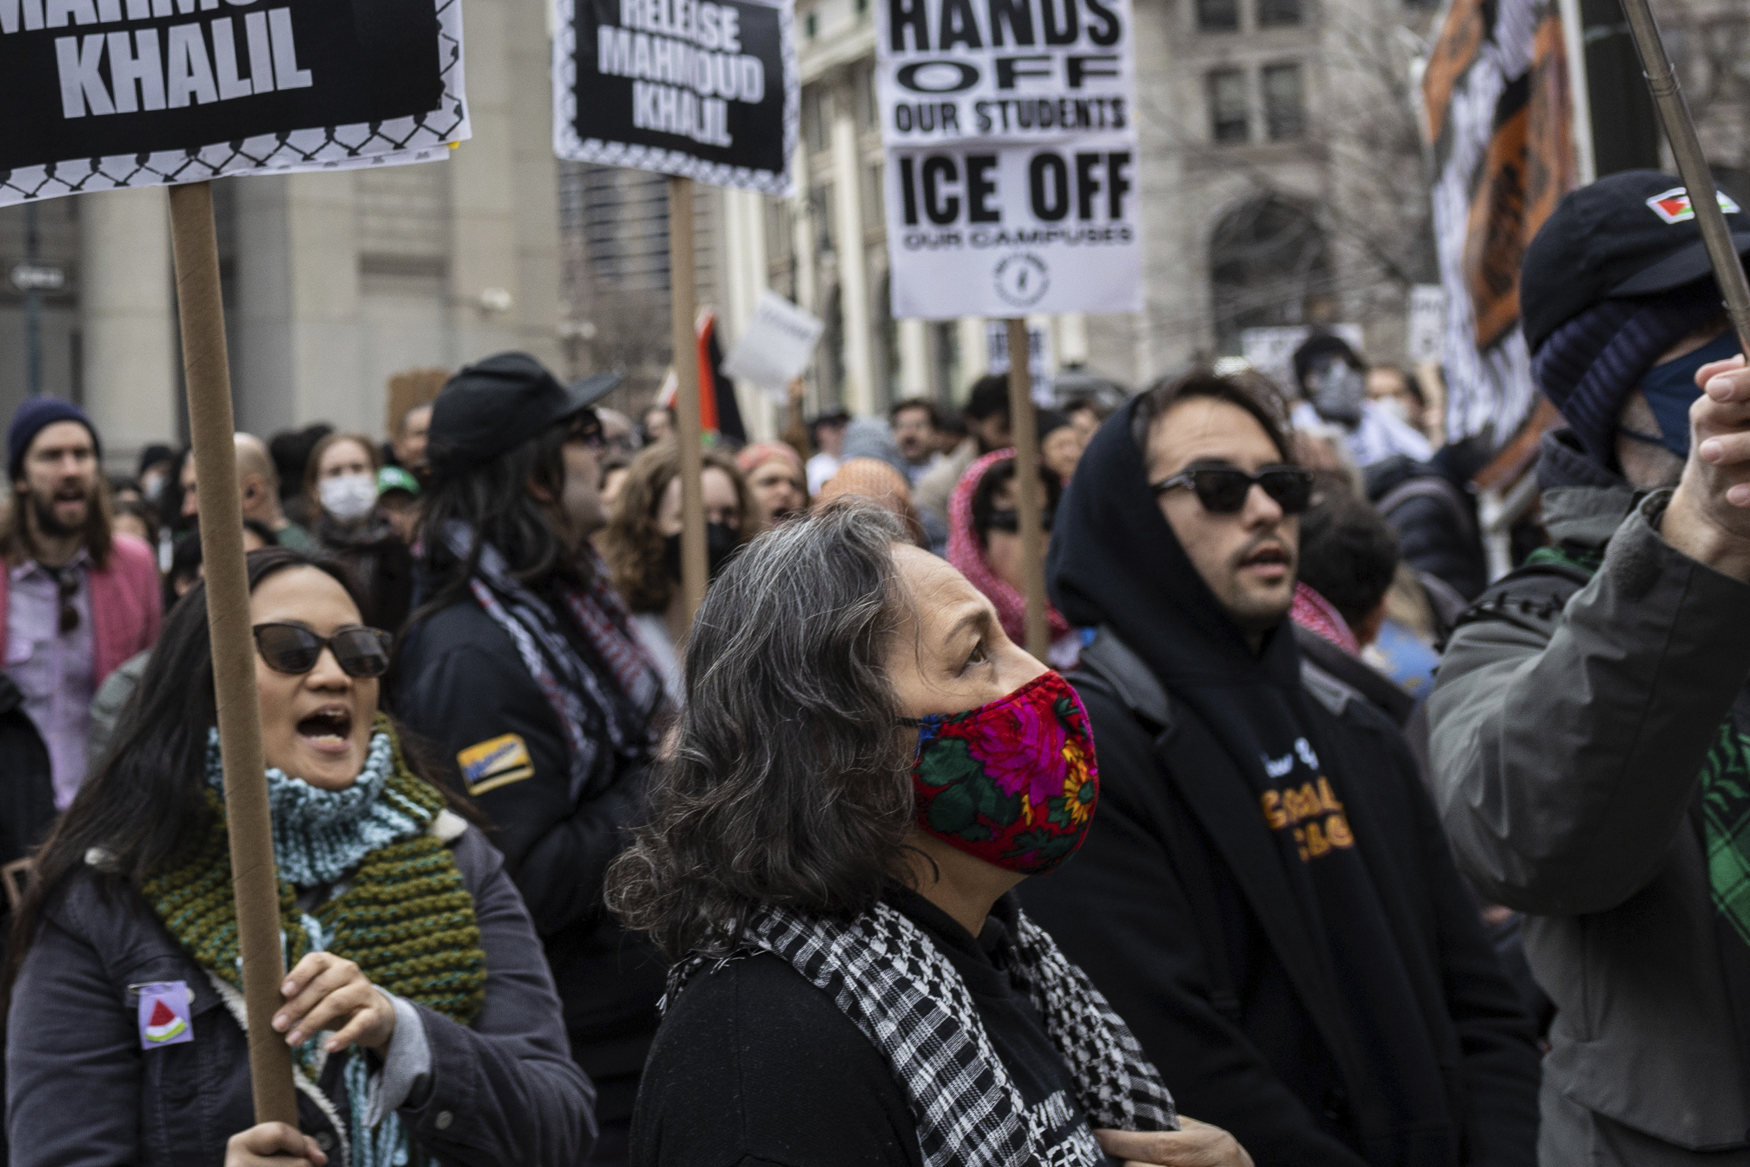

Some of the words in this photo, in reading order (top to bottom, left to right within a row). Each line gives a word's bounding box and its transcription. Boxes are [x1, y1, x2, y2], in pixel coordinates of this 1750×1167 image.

[55, 6, 313, 120] KHALIL
[896, 55, 1119, 93] OFF
[895, 102, 960, 133] OUR
[974, 97, 1127, 132] STUDENTS
[900, 155, 1001, 226] ICE
[1029, 151, 1131, 223] OFF
[903, 231, 964, 252] OUR
[969, 227, 1135, 250] CAMPUSES
